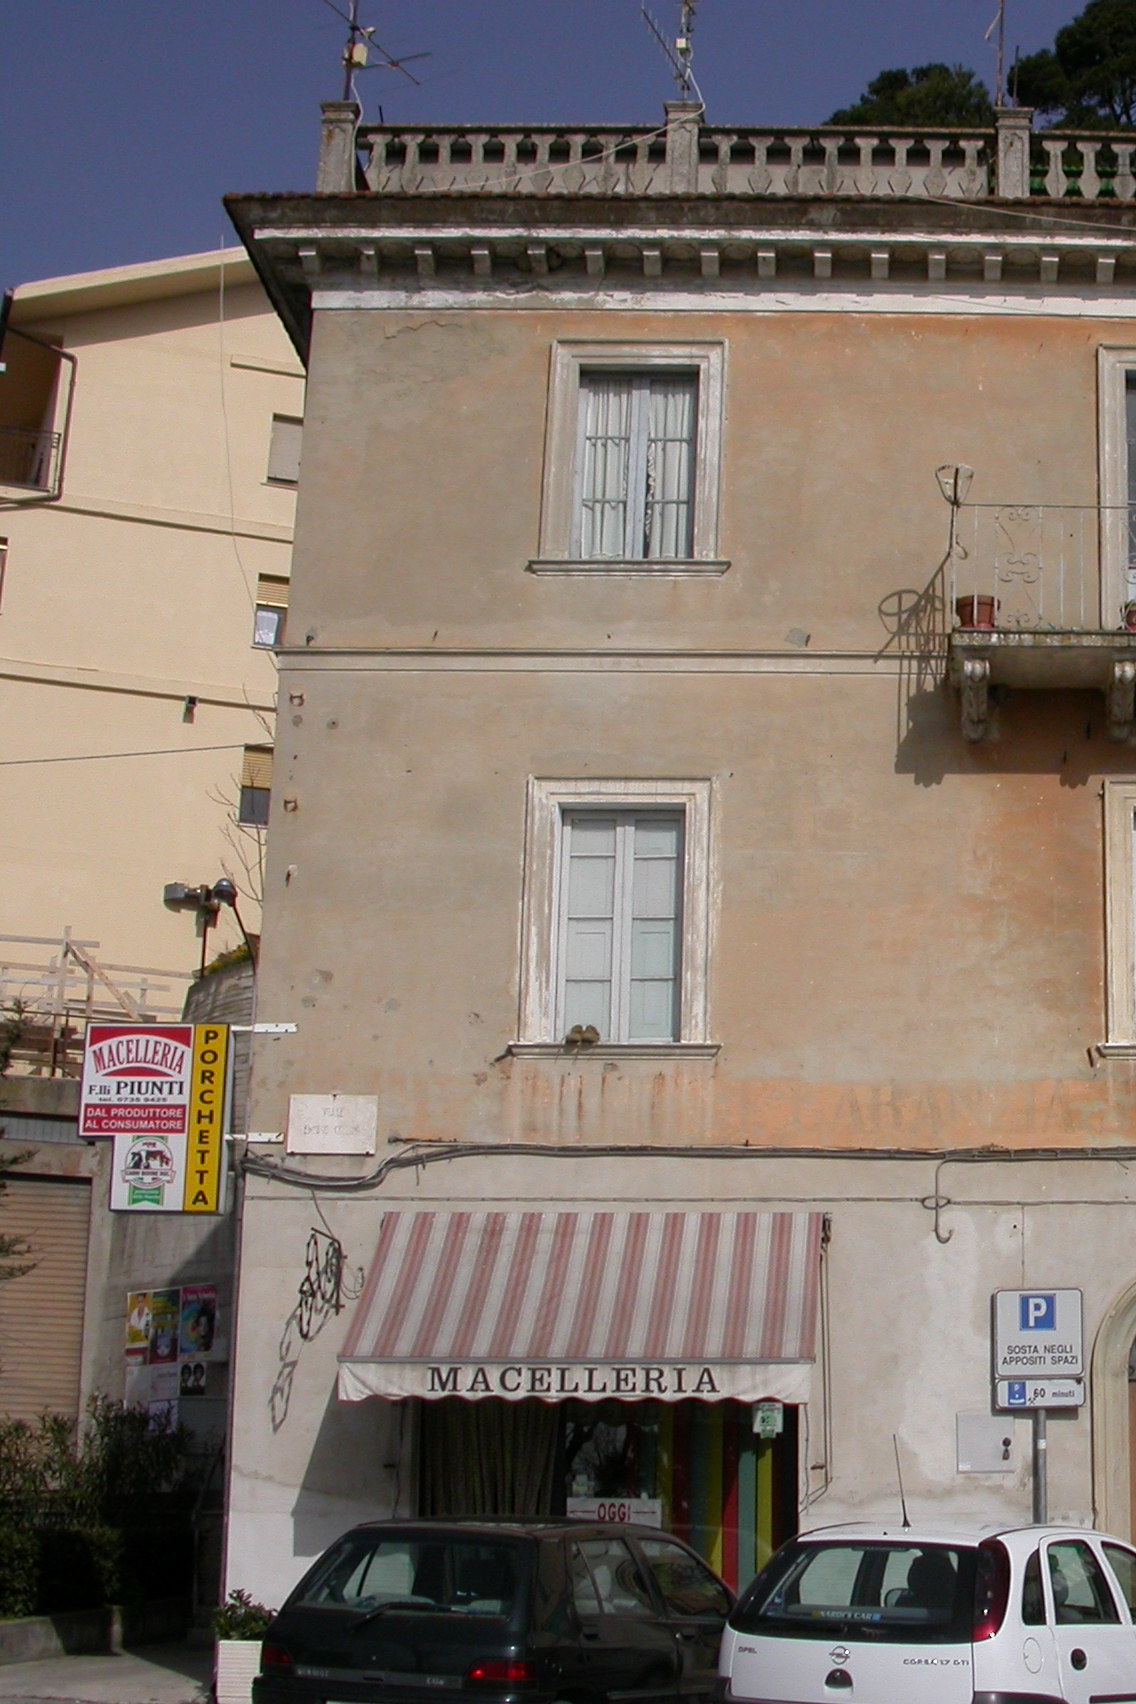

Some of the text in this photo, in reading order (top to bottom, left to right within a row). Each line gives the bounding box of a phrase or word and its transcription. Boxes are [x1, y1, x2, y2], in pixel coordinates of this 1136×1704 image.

[92, 1038, 186, 1075] MACELLERIA
[115, 1080, 184, 1095] PIUNTI
[86, 1107, 183, 1118] DAL PRODUTTORE
[191, 1029, 219, 1206] PORCHETTA
[84, 1119, 183, 1130] AL CONSUMATORE
[1027, 1297, 1048, 1328] P
[1006, 1344, 1073, 1355] SOSTA NEGLI
[1001, 1355, 1078, 1366] APPOSITI SPAZI
[426, 1366, 721, 1394] MACELLERIA
[1033, 1387, 1075, 1398] 60 minuti
[597, 1502, 632, 1522] OGGI
[737, 1646, 758, 1654] OPEL
